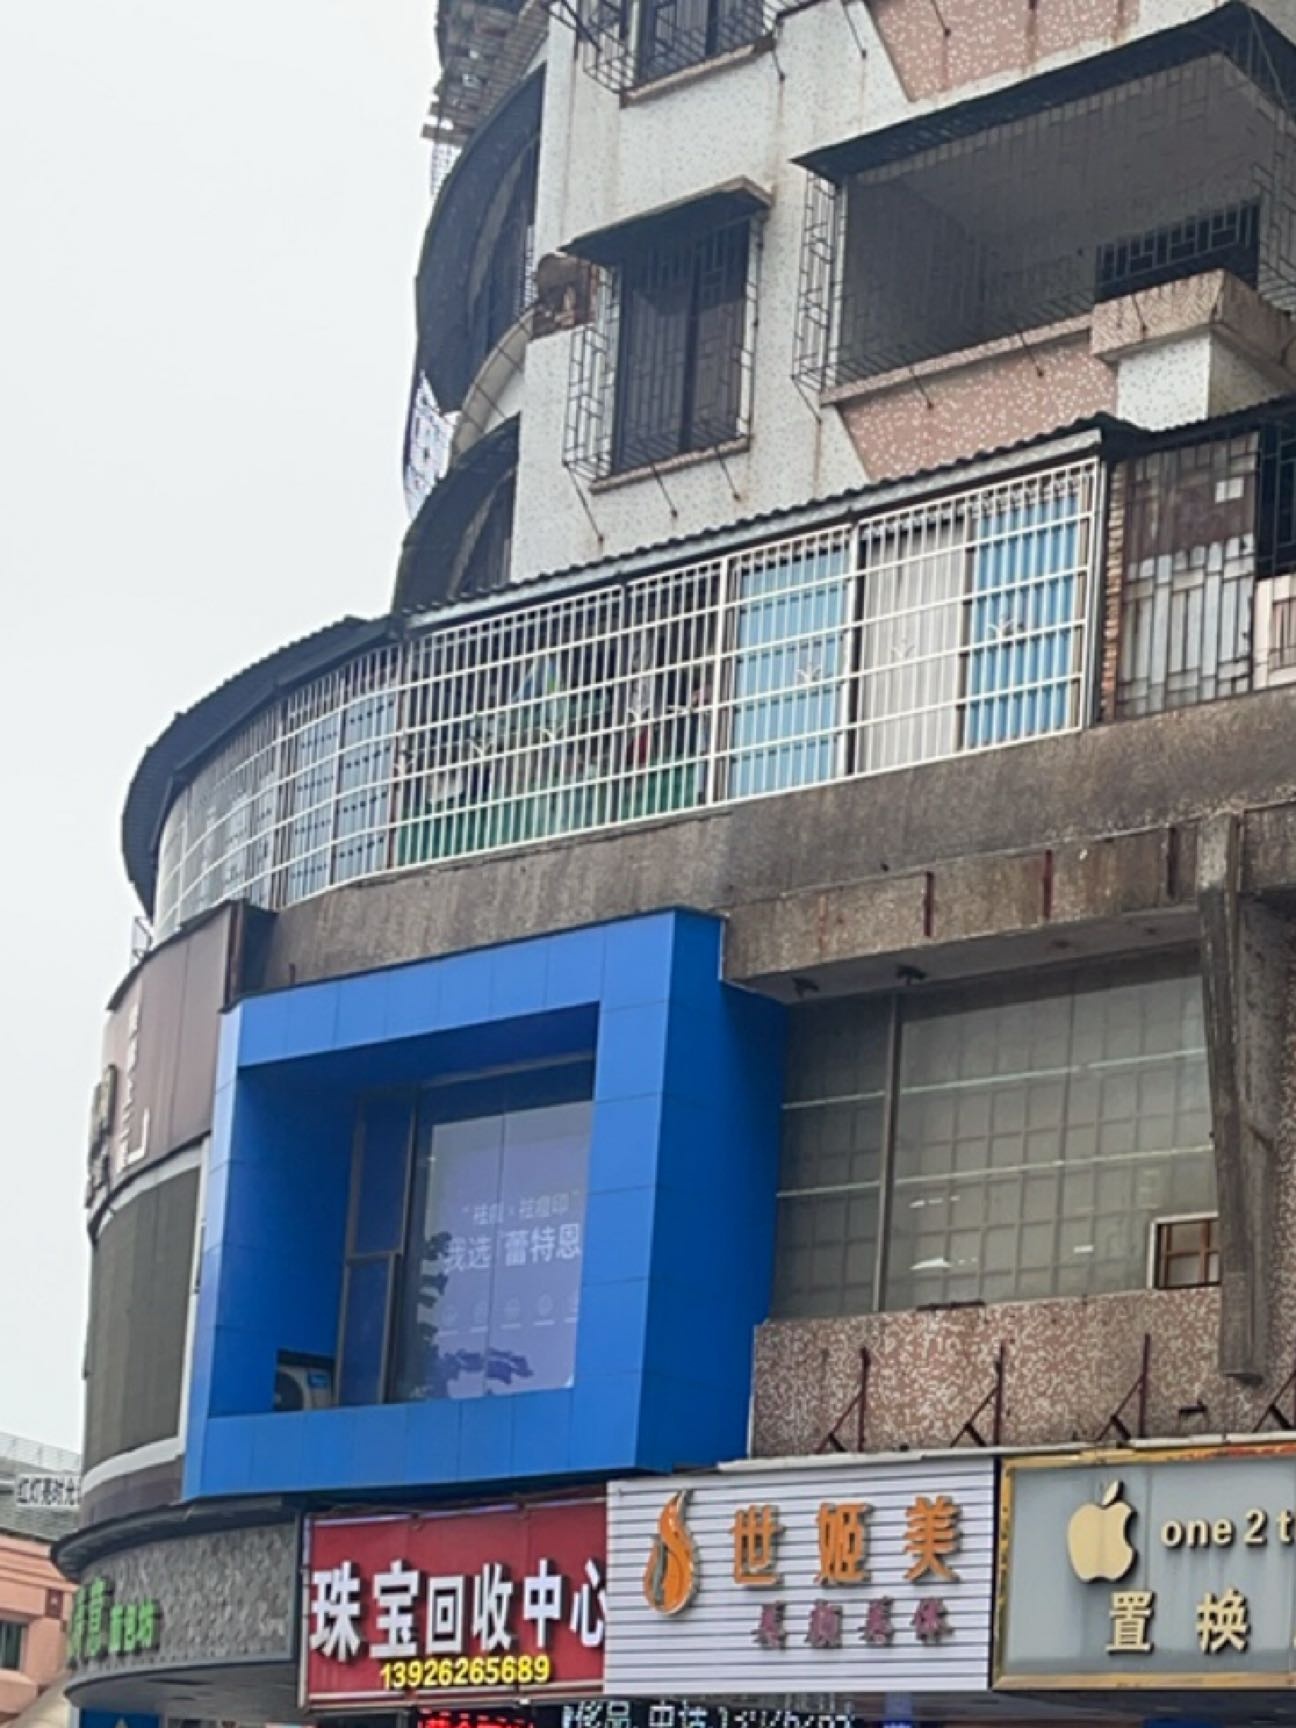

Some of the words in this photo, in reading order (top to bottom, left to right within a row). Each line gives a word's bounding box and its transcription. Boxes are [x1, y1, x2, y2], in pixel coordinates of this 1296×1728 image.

[1160, 1515, 1233, 1549] one
[1244, 1508, 1267, 1546] 2
[309, 1557, 606, 1664] 珠宝回收中心
[380, 1655, 550, 1689] 13926265689
